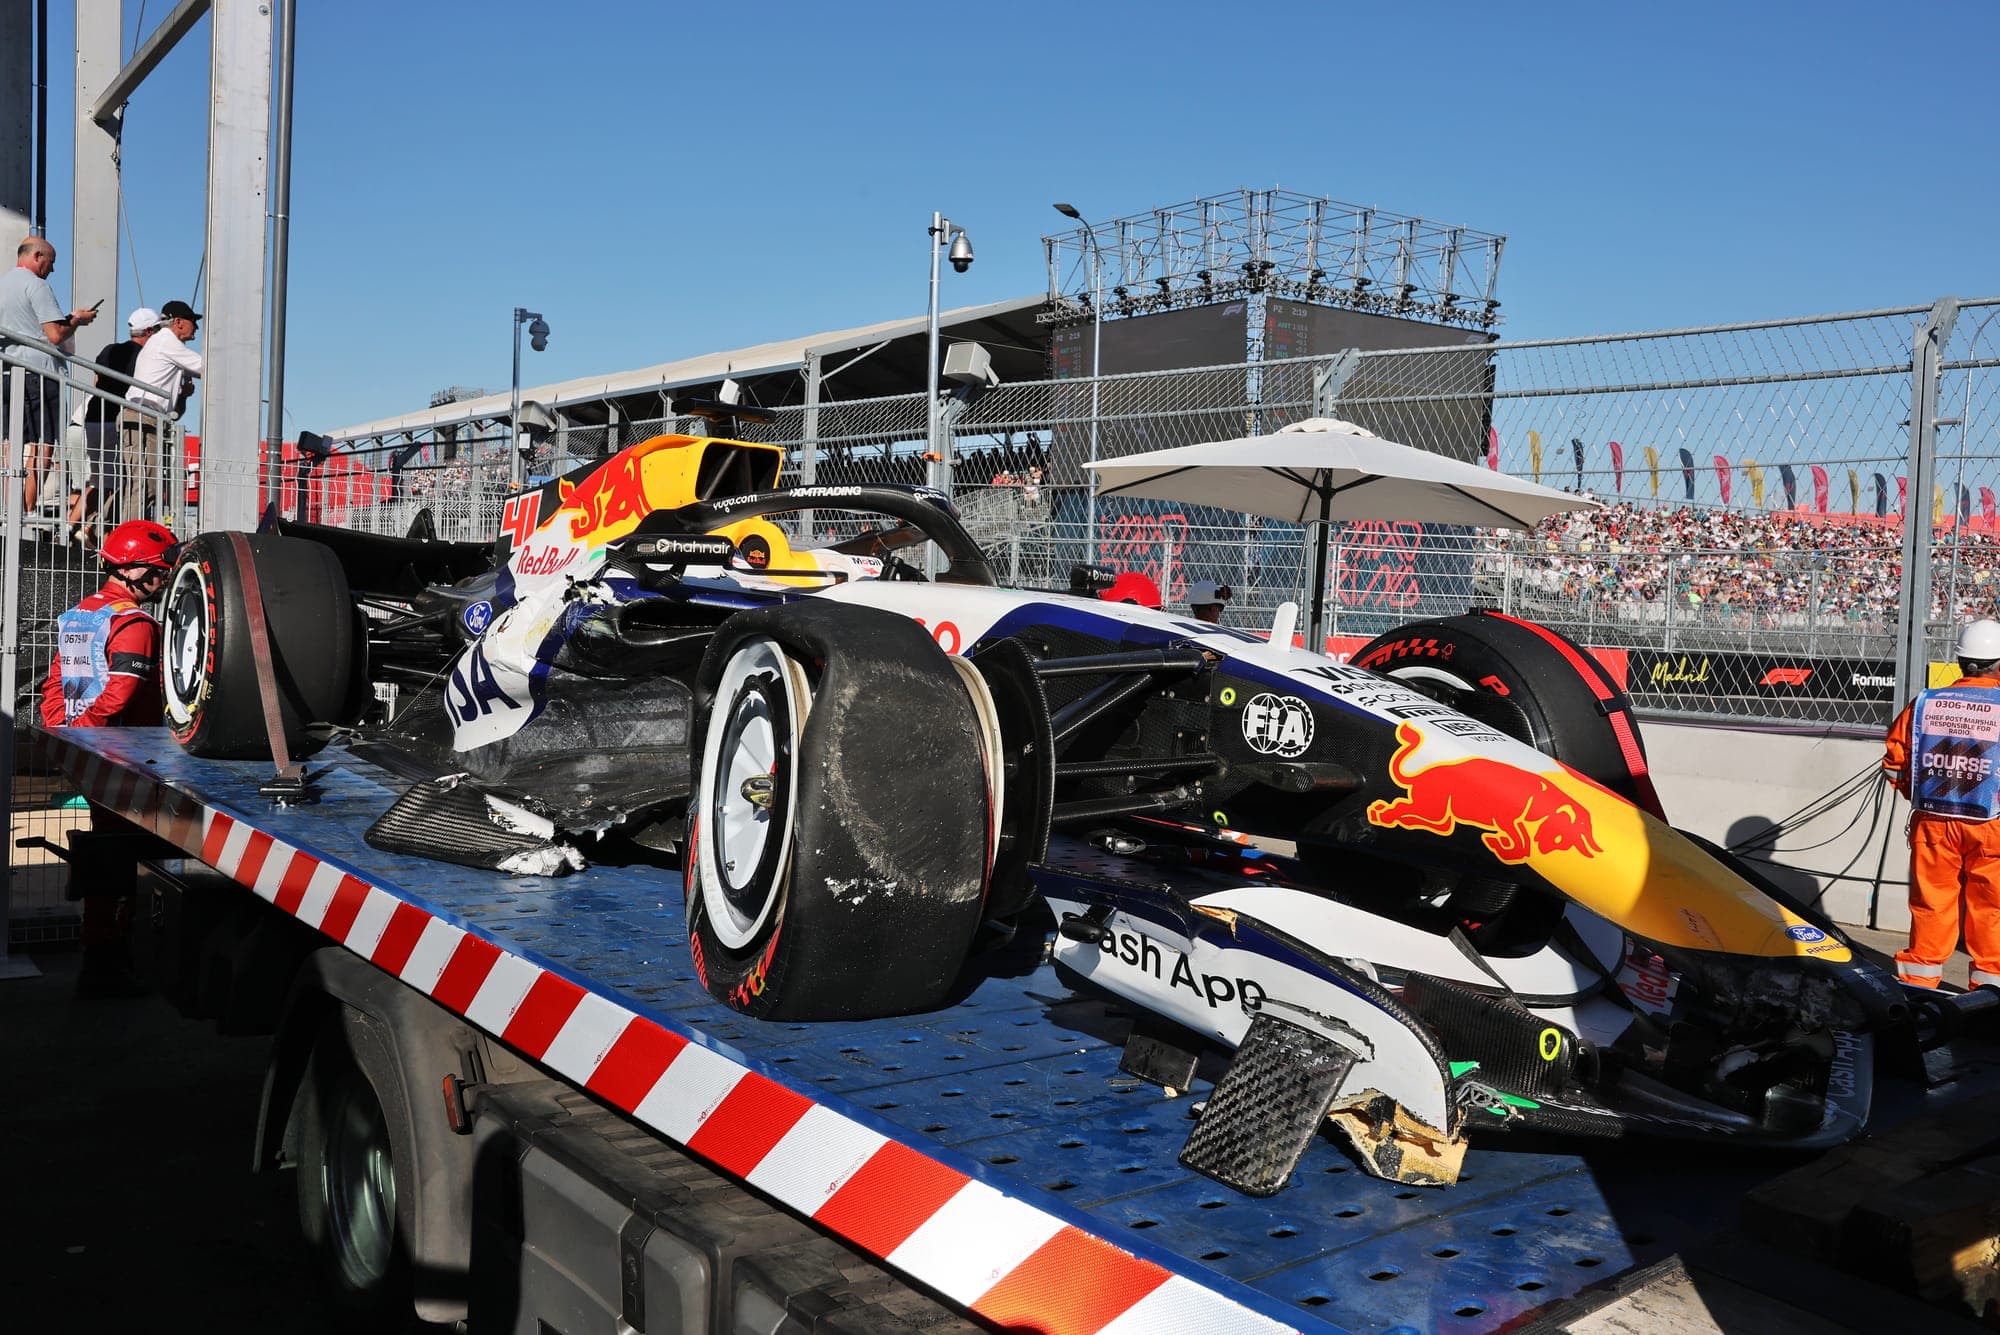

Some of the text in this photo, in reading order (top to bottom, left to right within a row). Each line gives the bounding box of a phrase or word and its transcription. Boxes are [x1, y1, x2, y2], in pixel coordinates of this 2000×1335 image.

[501, 491, 542, 550] 41
[673, 540, 731, 555] hahnair
[852, 557, 882, 567] Mobil
[1650, 656, 1710, 687] Madrid
[1935, 701, 1991, 713] 0306-MAD
[1930, 720, 1976, 730] RESPONSIBLE
[1949, 728, 1970, 736] RADIO
[1922, 753, 1993, 775] COURSE
[1928, 769, 1984, 782] ACCESS
[1791, 927, 1822, 941] Ford
[1098, 928, 1267, 1012] ash App
